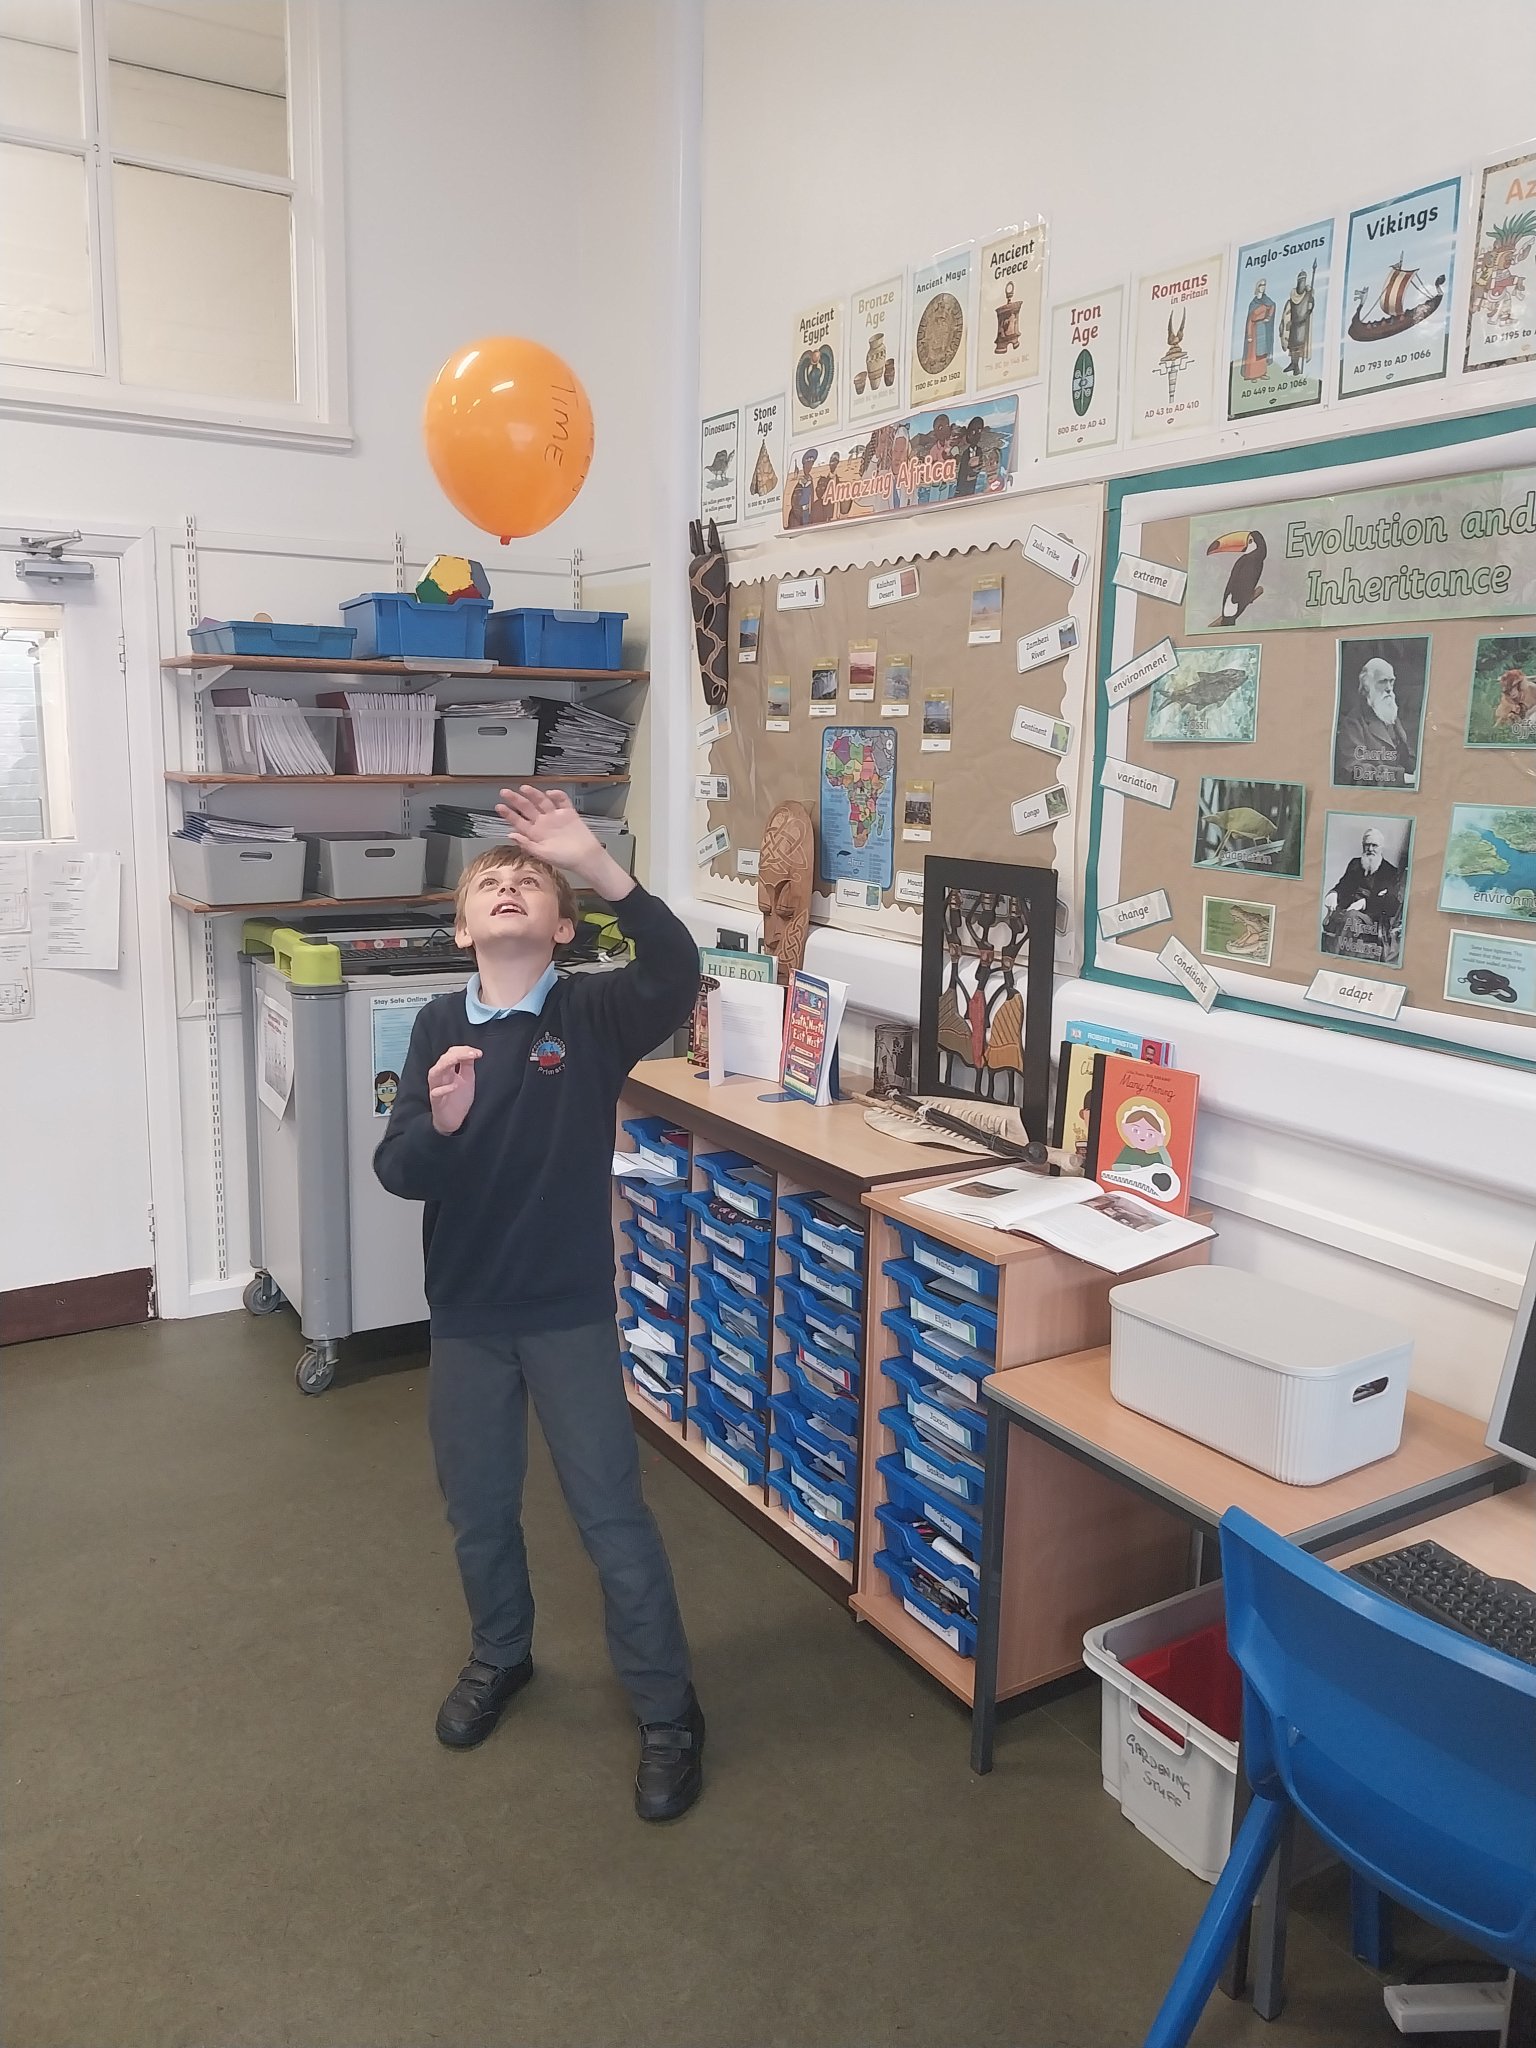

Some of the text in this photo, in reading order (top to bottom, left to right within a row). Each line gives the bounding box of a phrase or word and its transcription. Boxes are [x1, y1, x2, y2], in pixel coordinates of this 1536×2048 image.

[1366, 206, 1438, 241] Vikings
[990, 239, 1035, 268] Ancient
[1245, 235, 1325, 269] Anglo-Saxons
[994, 259, 1028, 280] Greece
[916, 268, 966, 294] Ancient Maya
[1152, 273, 1208, 300] Romans
[858, 291, 895, 314] Bronze
[1170, 287, 1209, 305] in Britain
[800, 308, 834, 332] Ancient
[866, 311, 885, 329] Age
[1070, 304, 1101, 326] Iron
[803, 323, 829, 345] Egypt
[1071, 325, 1099, 346] Age
[1484, 334, 1498, 345] AD
[1522, 329, 1532, 338] to
[1354, 349, 1431, 374] AD 793 to AD 1066
[934, 378, 939, 386] to
[939, 375, 947, 383] AD
[1241, 378, 1307, 398] AD 449 to AD 1066
[753, 405, 777, 421] Stone
[1144, 400, 1199, 419] AD 43 to AD 410
[545, 376, 579, 467] TIME
[704, 420, 736, 437] Dinosaurs
[757, 421, 773, 437] Age
[1087, 420, 1097, 429] AD
[1098, 418, 1106, 426] 43
[822, 455, 957, 505] Amazing Africa
[1285, 490, 1536, 559] Evolution and
[1032, 539, 1060, 561] Zulu Tribe
[1132, 568, 1168, 589] extreme
[1305, 563, 1512, 607] Inheritance
[878, 590, 894, 600] Desert
[1025, 633, 1050, 651] Zambezi
[1031, 648, 1046, 660] River
[1112, 652, 1169, 695] environment
[1020, 720, 1048, 737] Continent
[1354, 745, 1397, 762] Charles
[1116, 770, 1158, 793] variation
[1353, 765, 1396, 782] Darwin
[1023, 807, 1040, 820] Congo
[1117, 903, 1150, 923] change
[1343, 917, 1379, 937] Alfred
[1339, 937, 1383, 957] Wallace
[707, 963, 765, 982] HUE BOY
[1173, 952, 1208, 994] conditions
[374, 998, 388, 1006] Stay
[406, 995, 428, 1003] Online
[1338, 982, 1374, 1004] adapt
[1119, 1073, 1176, 1102] Mary Anning
[935, 1257, 955, 1275] Nancy
[1126, 1733, 1191, 1800] GARDENING
